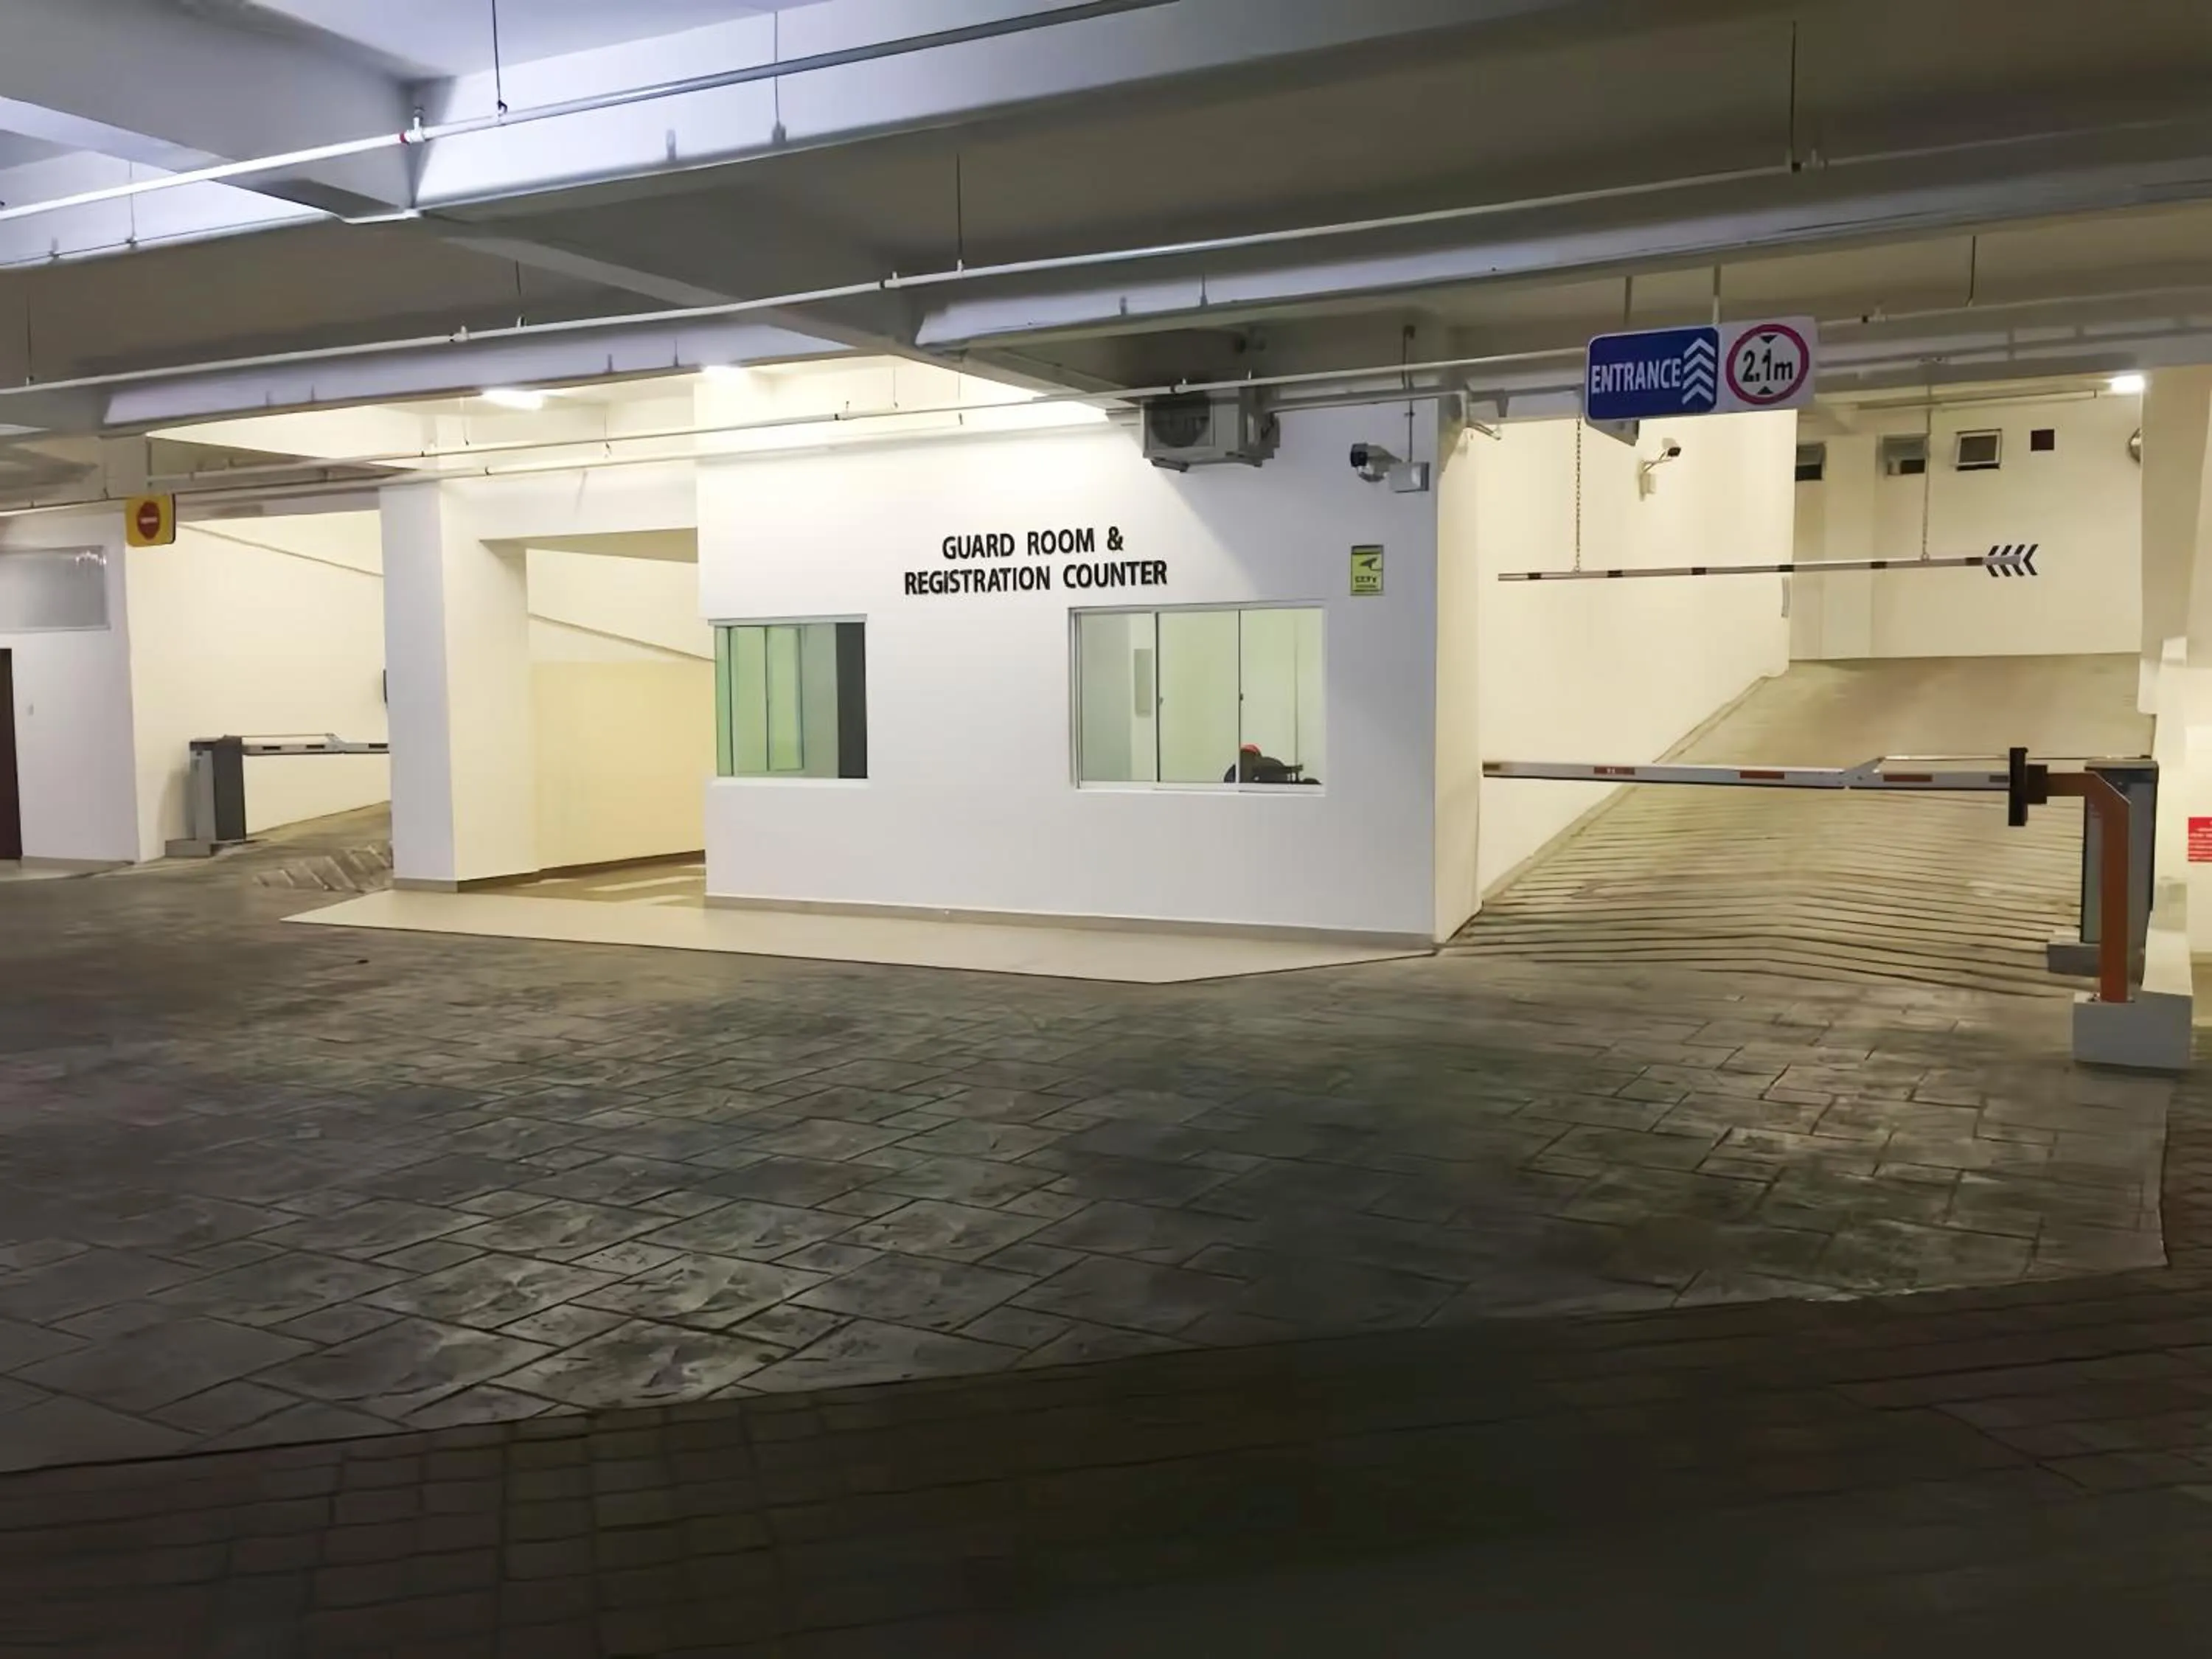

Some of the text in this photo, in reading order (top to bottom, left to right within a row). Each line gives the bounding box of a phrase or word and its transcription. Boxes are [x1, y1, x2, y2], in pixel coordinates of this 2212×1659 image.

[1591, 358, 1682, 394] ENTRANCE
[1742, 349, 1793, 383] 2.1m
[942, 526, 1124, 560] GUARD ROOM &
[904, 560, 1168, 595] REGISTRATION COUNTER
